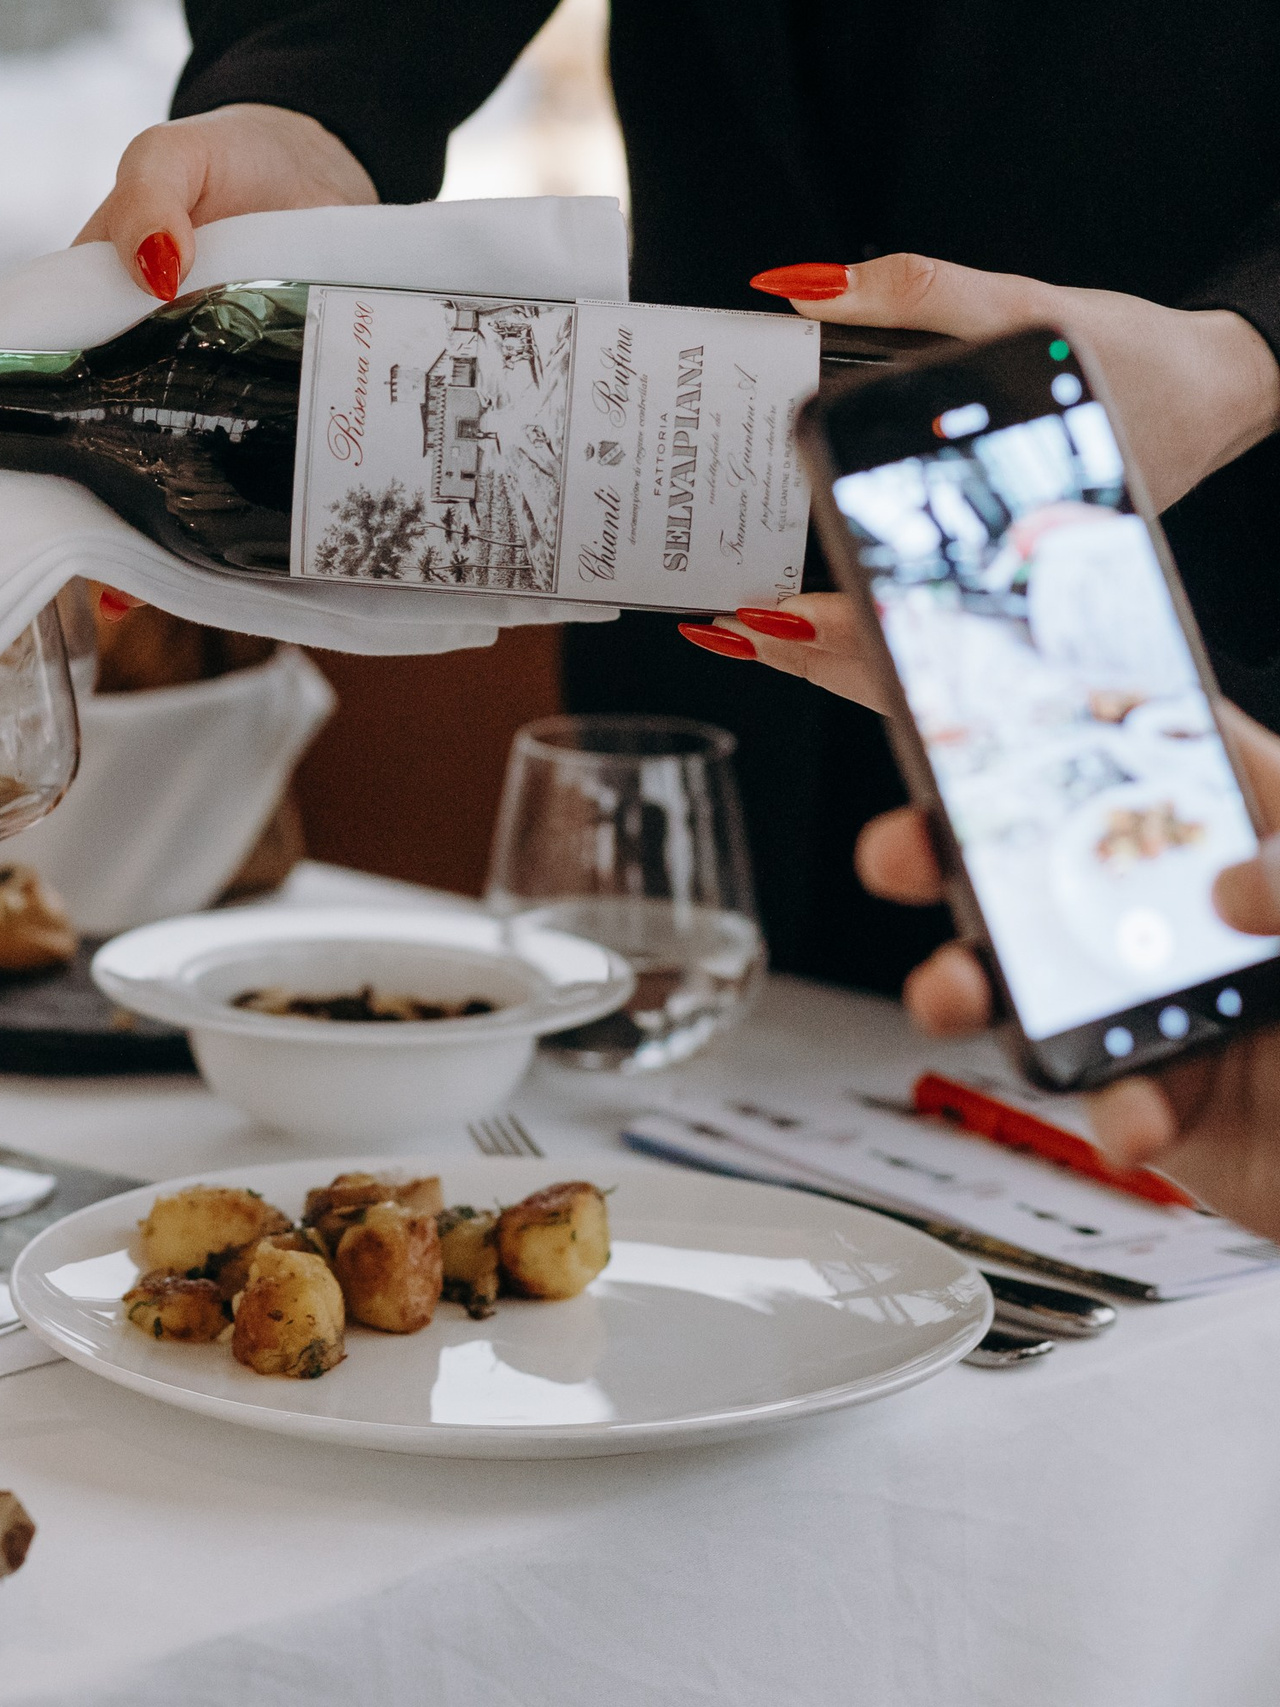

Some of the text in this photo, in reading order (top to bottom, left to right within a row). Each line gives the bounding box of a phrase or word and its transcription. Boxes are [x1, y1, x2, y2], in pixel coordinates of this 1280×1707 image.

[327, 300, 374, 467] Riserva 1980
[637, 373, 648, 427] controllata
[578, 324, 637, 583] Chianti Rufina
[653, 412, 668, 496] FATTORIA
[662, 345, 704, 572] SELVAPIANA
[726, 404, 758, 487] Giuntini
[719, 489, 748, 566] Francesco
[780, 473, 790, 507] CANTINE
